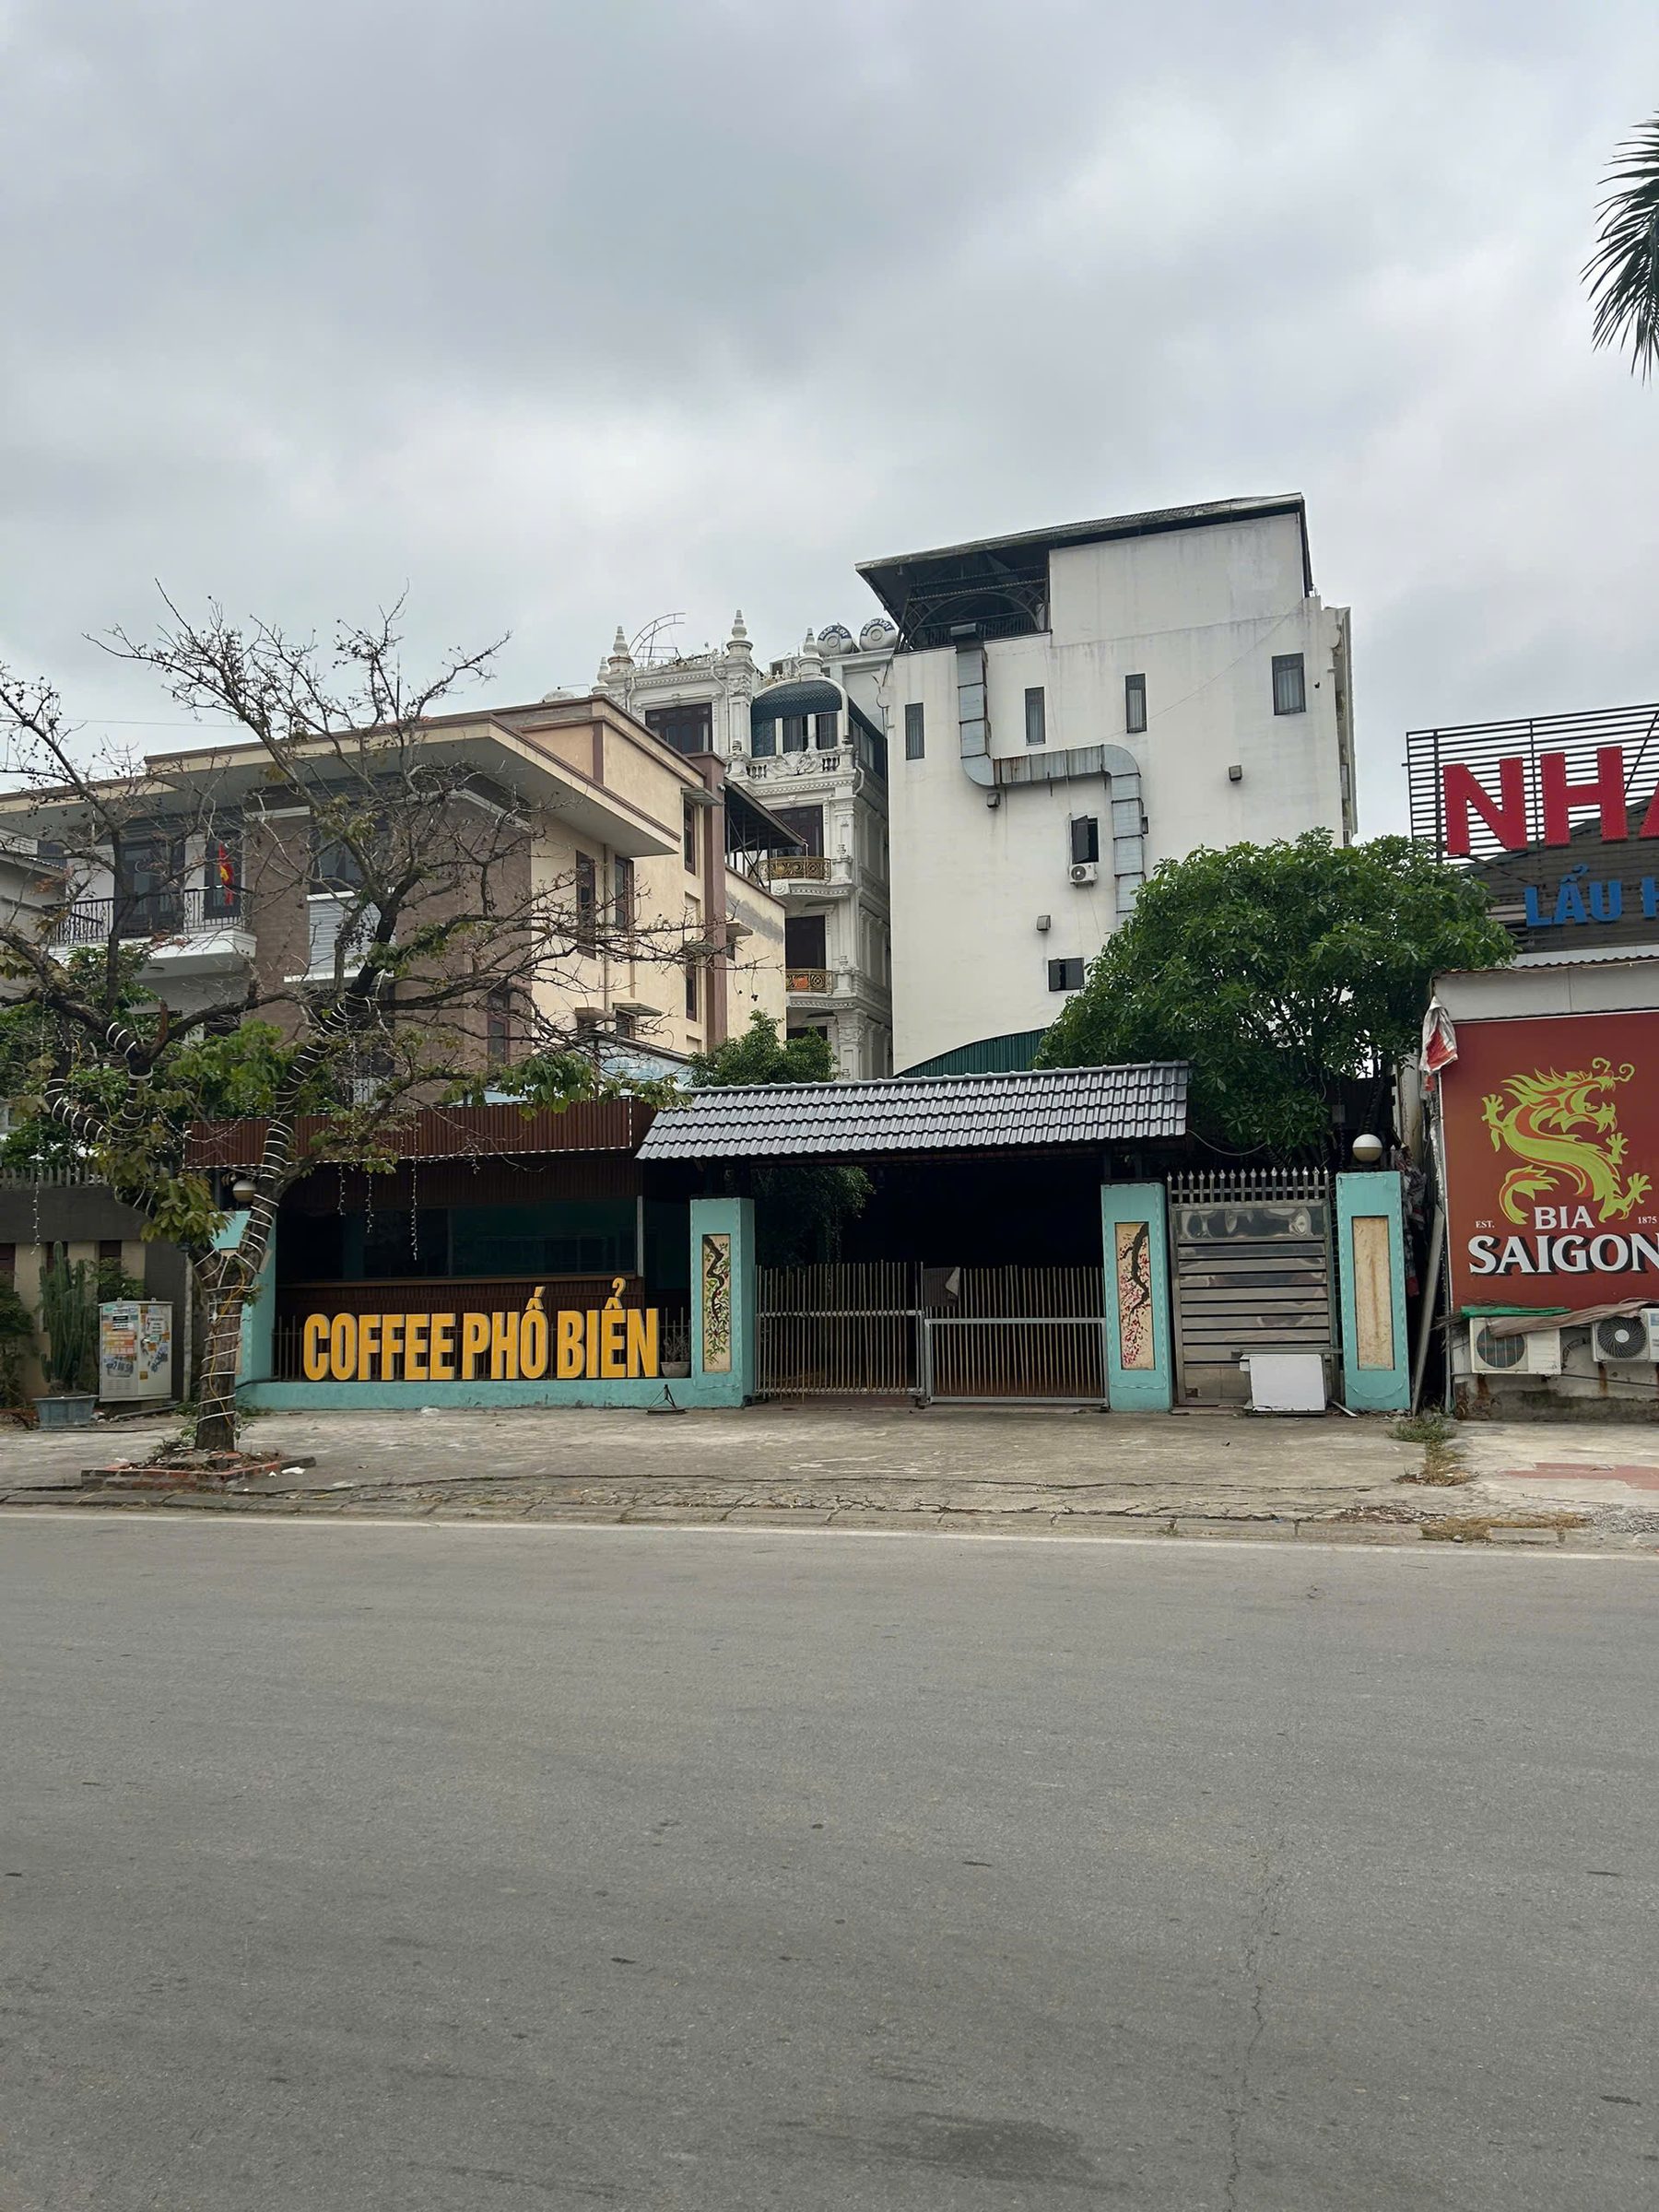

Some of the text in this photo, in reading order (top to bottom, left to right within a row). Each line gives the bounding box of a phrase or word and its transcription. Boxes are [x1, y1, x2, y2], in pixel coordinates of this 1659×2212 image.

[1442, 746, 1659, 855] NH
[1524, 863, 1622, 928] LẨU
[1475, 1219, 1495, 1229] EST.
[1534, 1205, 1595, 1230] BIA
[1637, 1216, 1657, 1225] 1875
[1467, 1232, 1659, 1276] SAIGON
[303, 1277, 660, 1381] COFFEE PHỐ BIỂN
